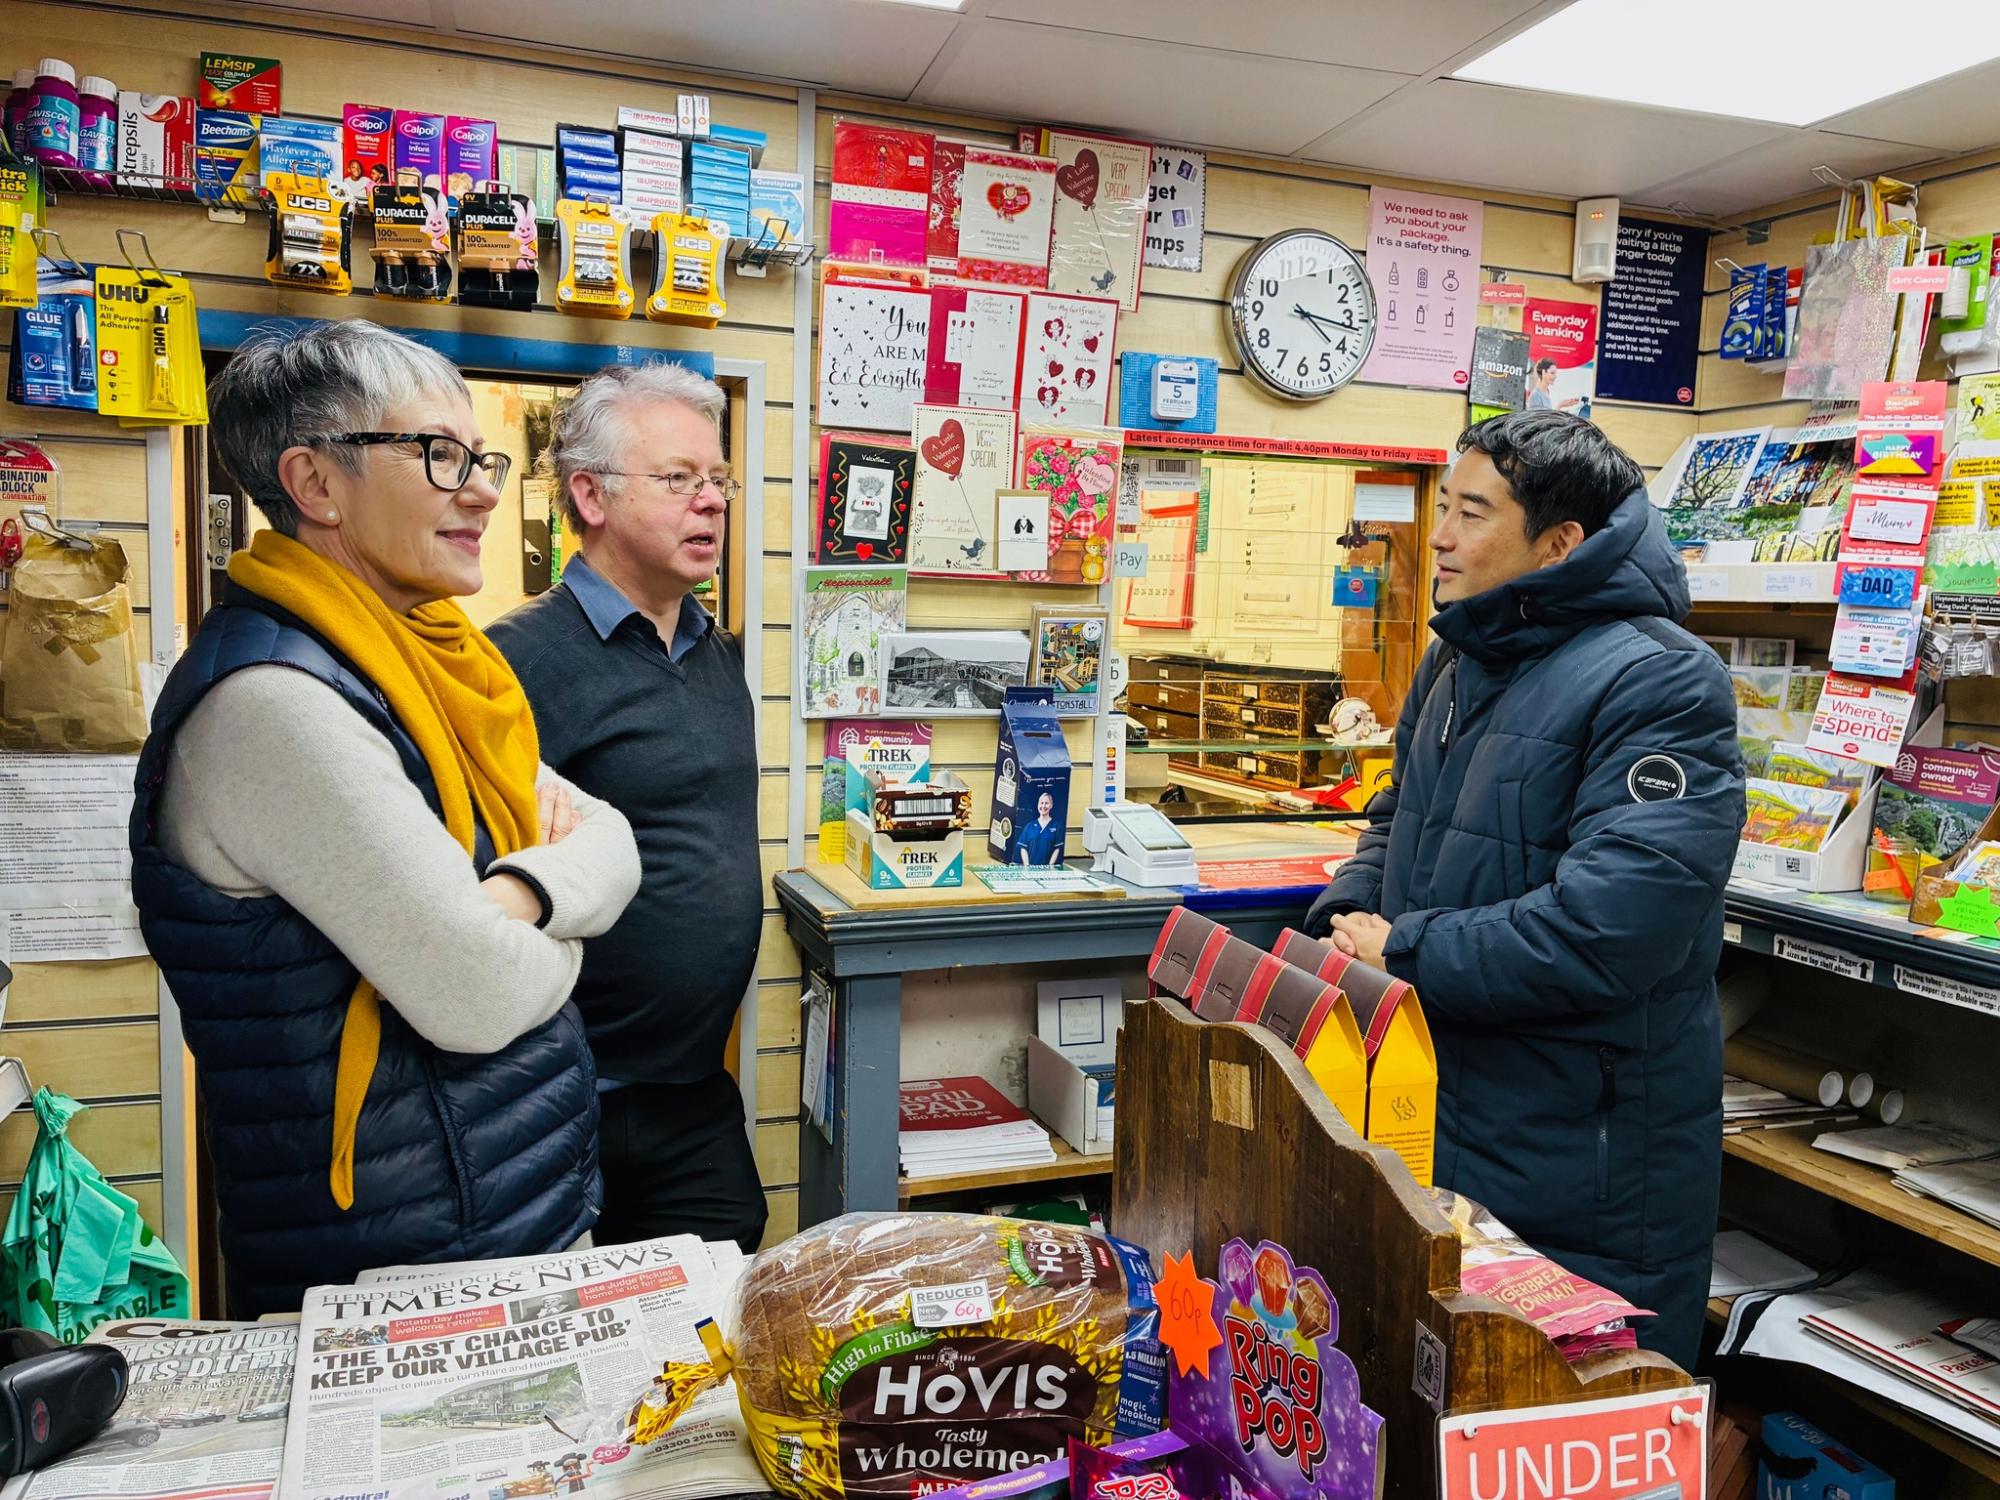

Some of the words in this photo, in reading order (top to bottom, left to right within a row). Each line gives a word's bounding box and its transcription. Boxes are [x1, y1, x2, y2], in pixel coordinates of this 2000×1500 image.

[206, 58, 256, 72] LEMSIP
[201, 123, 251, 137] Beechams
[352, 118, 383, 131] Calpol
[404, 123, 434, 135] Calpol
[455, 129, 485, 142] Calpol
[123, 111, 138, 180] Strepsils
[265, 143, 310, 156] Hayfever
[312, 149, 331, 159] and
[1074, 161, 1090, 177] Little
[1111, 162, 1128, 180] VERY
[1104, 181, 1131, 199] SPECIAL
[288, 195, 331, 212] JCB
[1384, 201, 1403, 212] We
[1405, 205, 1433, 217] need
[1436, 208, 1447, 218] to
[1449, 211, 1469, 222] ask
[375, 208, 426, 218] DURACELL
[466, 214, 517, 225] DURACELL
[576, 223, 614, 236] JCB
[1385, 214, 1405, 225] you
[1408, 217, 1439, 229] about
[1441, 221, 1467, 233] your
[377, 229, 396, 238] 100%
[467, 235, 486, 243] 100%
[1400, 227, 1450, 243] package.
[1644, 228, 1651, 237] if
[674, 236, 711, 251] JCB
[1404, 241, 1439, 254] safety
[1441, 245, 1472, 257] thing.
[1660, 242, 1682, 253] little
[1647, 251, 1676, 265] today
[297, 264, 320, 275] 7X
[1297, 256, 1316, 277] 12
[1643, 268, 1673, 277] regulations
[98, 283, 149, 303] UHU
[1499, 291, 1523, 299] Cards
[1609, 283, 1628, 291] longer
[1635, 286, 1656, 294] process
[1657, 288, 1680, 296] customs
[1609, 291, 1622, 299] data
[99, 304, 115, 313] The
[26, 313, 63, 325] GLUE
[99, 313, 112, 322] All
[113, 314, 149, 324] Purpose
[99, 321, 141, 331] Adhesive
[1532, 311, 1588, 328] Everyday
[1535, 325, 1584, 342] banking
[874, 346, 905, 361] ARE
[1478, 359, 1523, 376] amazon
[1173, 385, 1182, 398] 5
[941, 432, 955, 447] Little
[1130, 433, 1162, 444] Latest
[1166, 437, 1225, 448] acceptance
[1228, 438, 1250, 448] time
[1253, 440, 1266, 449] for
[1269, 440, 1292, 451] mail:
[1295, 443, 1330, 455] 4.40pm
[1332, 446, 1368, 457] Monday
[1371, 448, 1380, 457] to
[1383, 449, 1411, 460] Friday
[932, 443, 961, 463] Valentine
[970, 450, 997, 468] SPECIAL
[1873, 451, 1922, 459] BIRTHDAY
[943, 455, 960, 469] Wish
[2, 493, 47, 501] COMBINATION
[1872, 512, 1905, 528] Mum
[1120, 552, 1142, 569] Pay
[1861, 577, 1893, 594] DAD
[1875, 690, 1908, 702] Directory
[1832, 700, 1876, 720] Where
[1882, 712, 1894, 724] to
[1825, 717, 1891, 742] spend
[868, 749, 911, 762] TREK
[1921, 772, 1954, 783] owned
[1922, 763, 1978, 779] community
[901, 852, 938, 864] TREK
[1787, 940, 1807, 953] Padded
[1838, 955, 1859, 967] Bigger
[902, 1099, 986, 1116] PAD
[322, 1285, 482, 1320] TIMES
[488, 1278, 530, 1298] &
[538, 1246, 673, 1288] NEWS
[583, 1284, 606, 1294] Late
[607, 1278, 637, 1291] Judge
[585, 1290, 613, 1300] home
[626, 1284, 640, 1294] up
[642, 1280, 656, 1288] for
[659, 1275, 678, 1284] sale
[916, 1286, 983, 1302] REDUCED
[954, 1300, 983, 1319] 60p
[1169, 1280, 1201, 1335] 60p
[396, 1317, 431, 1327] Potato
[433, 1314, 452, 1323] Day
[455, 1309, 490, 1319] makes
[918, 1312, 940, 1322] price
[387, 1340, 455, 1363] LAST
[464, 1317, 574, 1352] CHANCE
[582, 1307, 615, 1326] TO
[396, 1323, 444, 1335] welcome
[310, 1366, 384, 1390] KEEP
[392, 1359, 448, 1379] OUR
[455, 1334, 570, 1369] VILLAGE
[825, 1347, 866, 1385] High
[869, 1343, 881, 1355] in
[881, 1327, 933, 1351] Fibre
[1225, 1316, 1321, 1409] Ring
[309, 1388, 363, 1401] Hundreds
[365, 1384, 398, 1395] object
[401, 1382, 412, 1390] to
[414, 1378, 442, 1389] plans
[457, 1372, 479, 1381] turn
[480, 1367, 507, 1378] Hare
[508, 1362, 527, 1374] and
[530, 1355, 567, 1369] Hounds
[570, 1352, 588, 1361] into
[590, 1341, 629, 1355] housing
[146, 1384, 184, 1394] centre
[187, 1379, 236, 1391] gateway
[873, 1364, 1068, 1415] HOVIS
[1120, 1397, 1146, 1411] magic
[1119, 1406, 1160, 1424] breakfast
[655, 1438, 690, 1453] 03300
[692, 1433, 714, 1443] 296
[716, 1430, 736, 1438] 093
[935, 1428, 988, 1447] Tasty
[596, 1447, 627, 1458] 20%
[1469, 1427, 1677, 1500] UNDER
